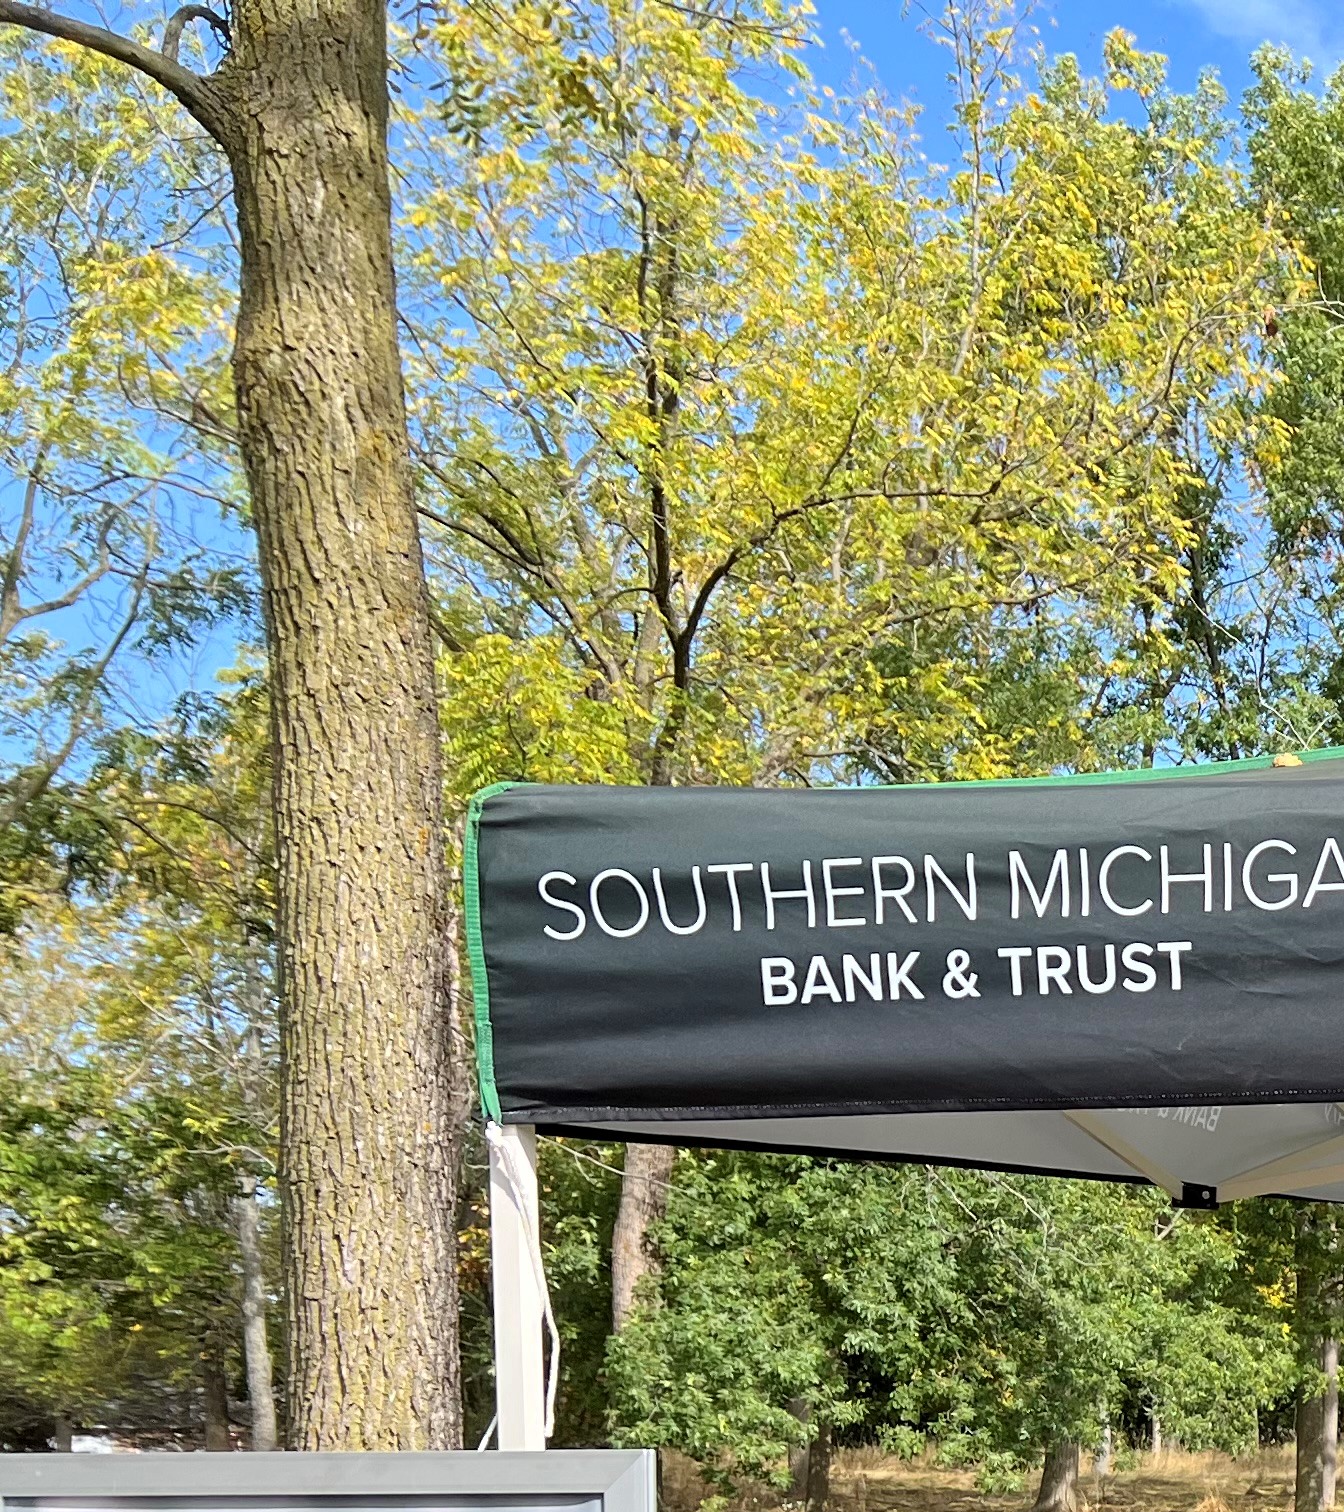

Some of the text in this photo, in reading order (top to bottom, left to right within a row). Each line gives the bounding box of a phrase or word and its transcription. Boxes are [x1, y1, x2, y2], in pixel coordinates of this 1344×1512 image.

[538, 851, 978, 941] SOUTHERN
[760, 941, 1194, 1007] BANK & TRUST
